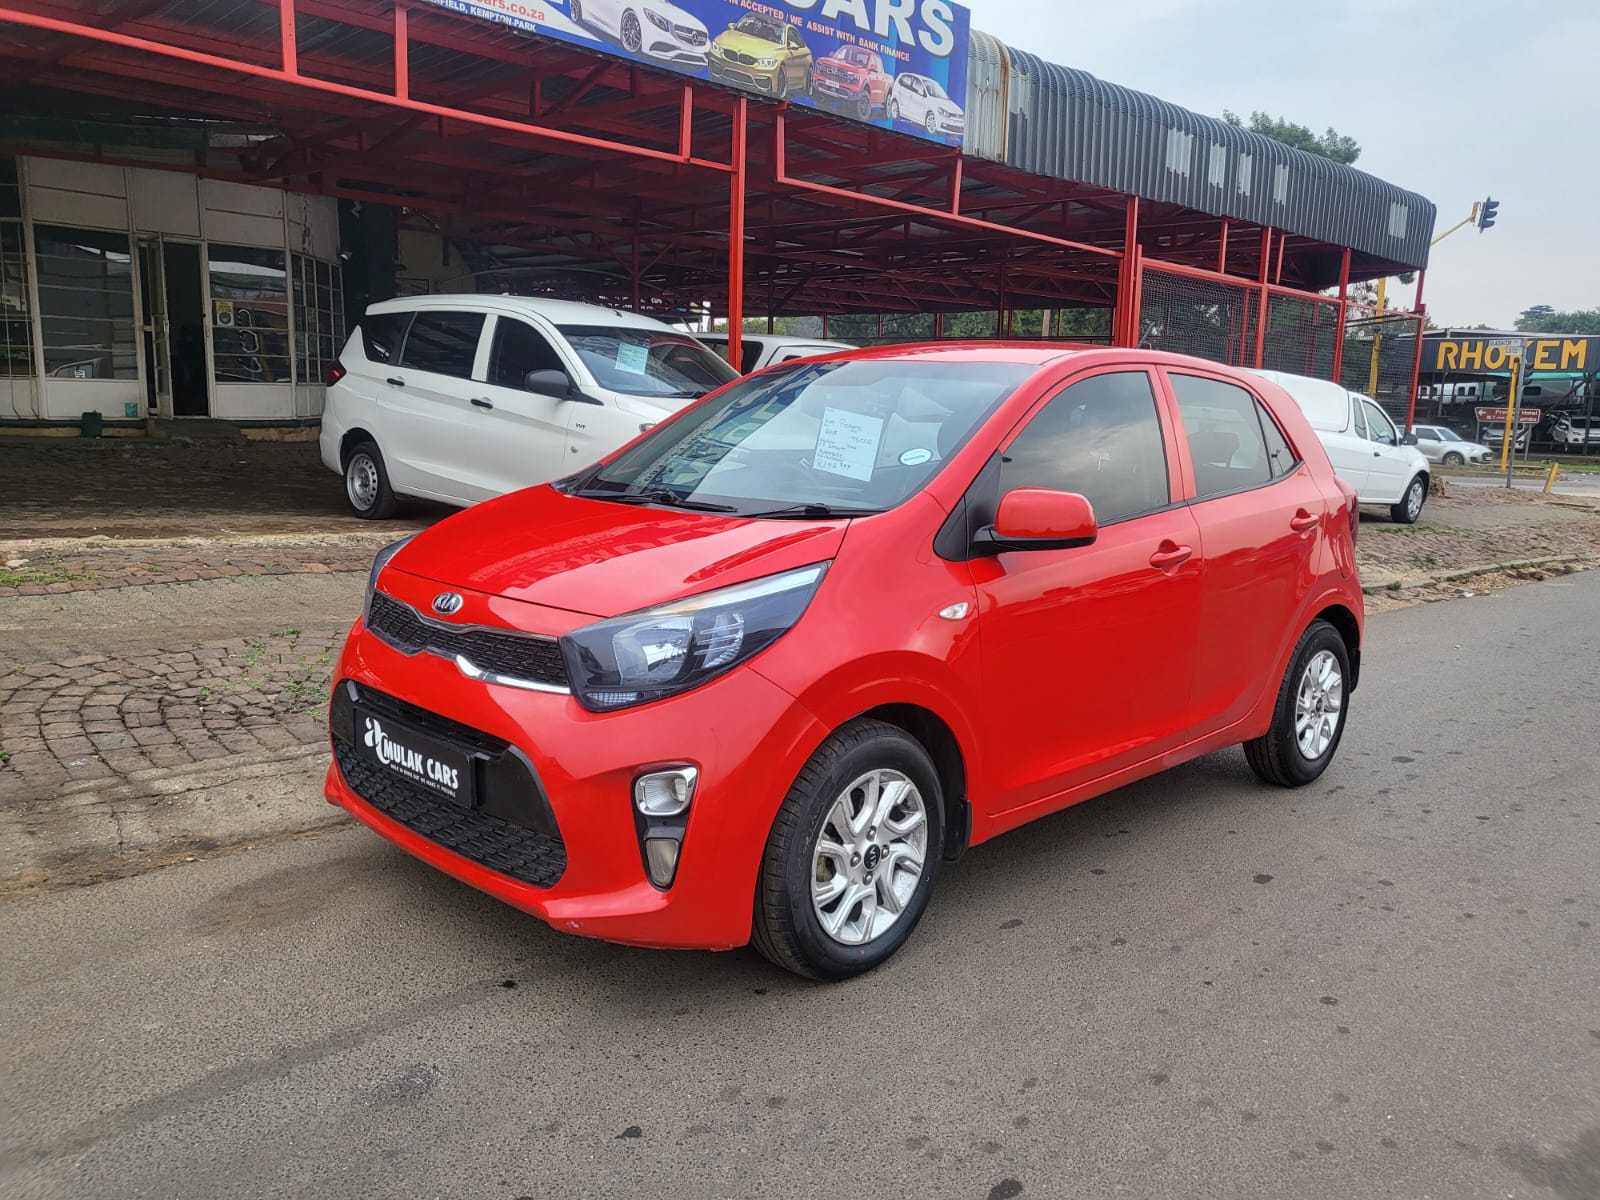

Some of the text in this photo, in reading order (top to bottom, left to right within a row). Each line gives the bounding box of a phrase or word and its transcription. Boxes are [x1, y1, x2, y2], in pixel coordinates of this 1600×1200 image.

[784, 0, 954, 57] ARS
[790, 14, 803, 26] WE
[806, 20, 835, 37] ASSIST
[836, 29, 856, 43] WITH
[858, 37, 879, 51] BANK
[880, 44, 911, 62] FINANCE
[426, 758, 459, 789] CARS
